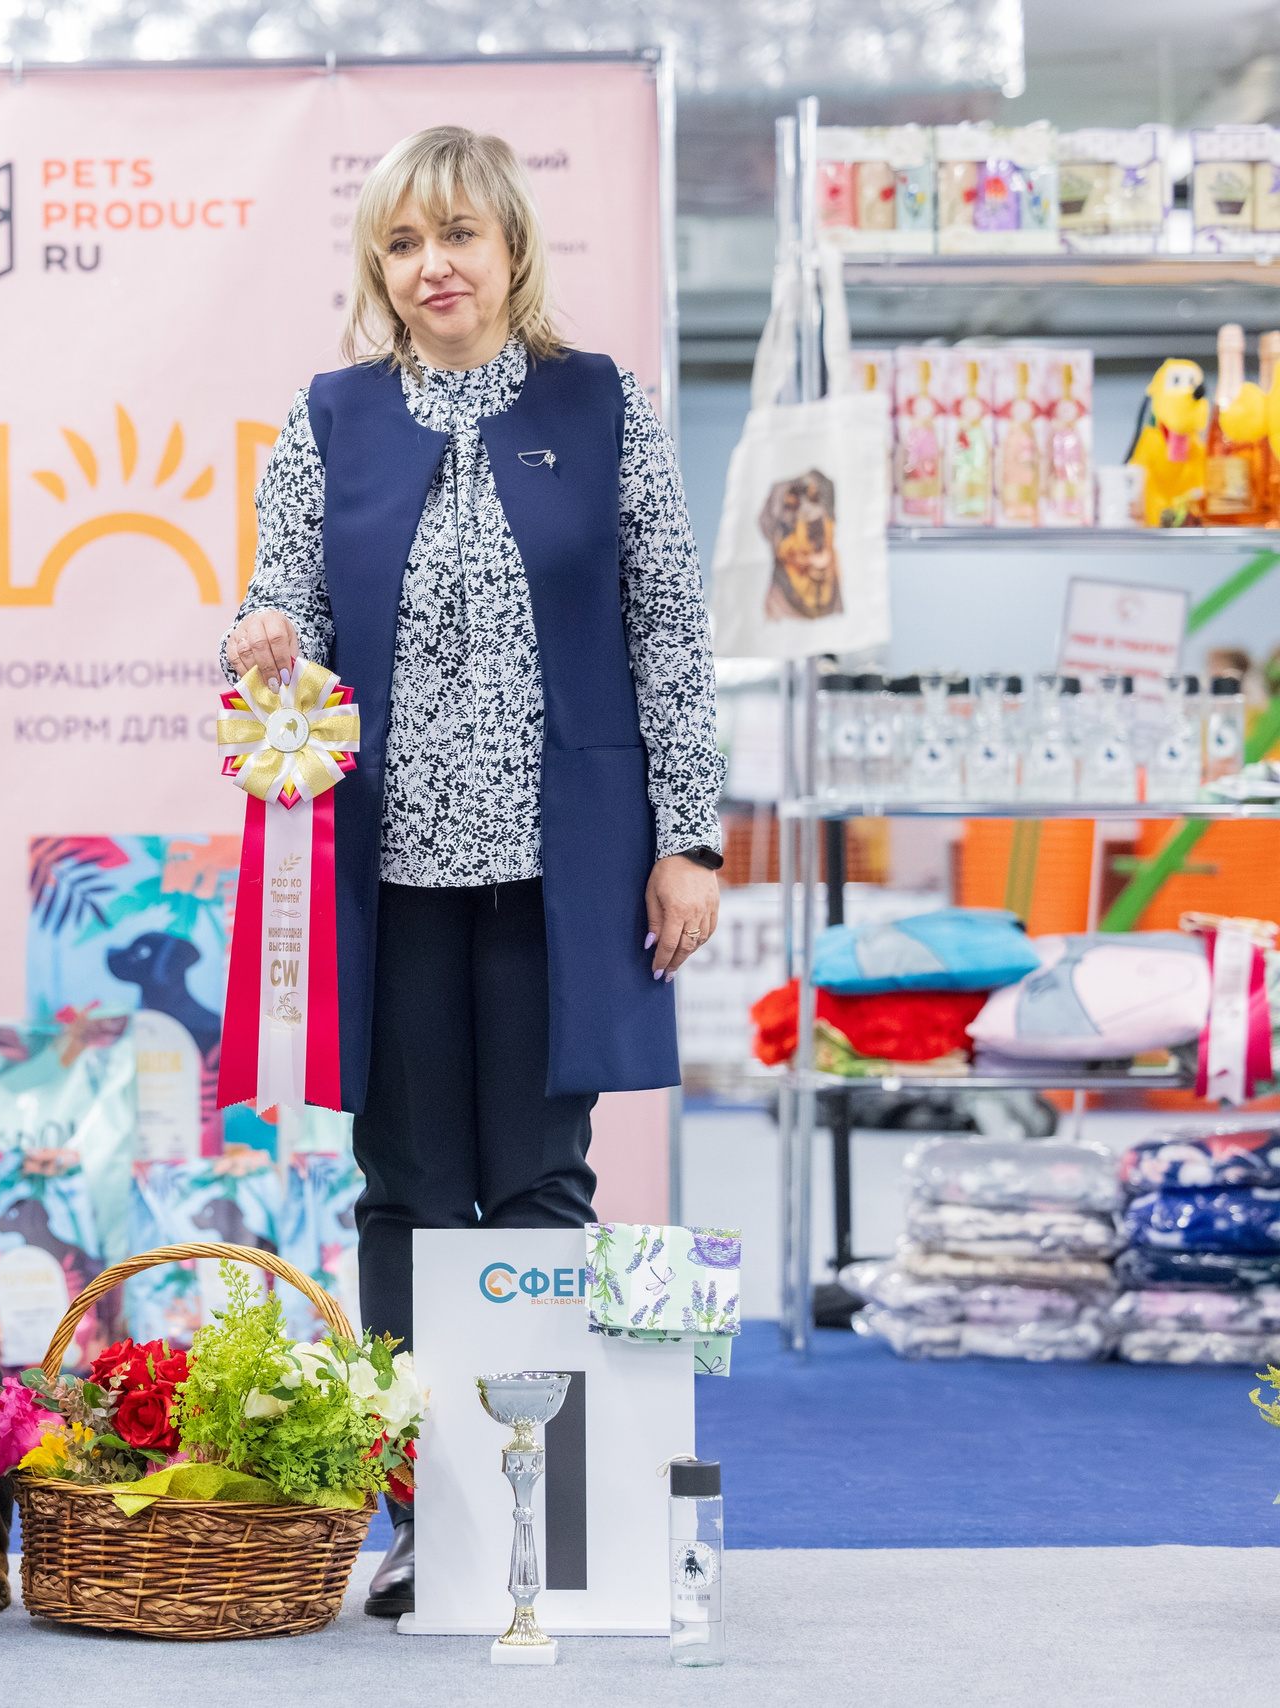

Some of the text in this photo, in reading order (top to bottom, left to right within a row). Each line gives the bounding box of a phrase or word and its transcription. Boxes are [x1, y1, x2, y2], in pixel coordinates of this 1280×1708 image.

[43, 159, 153, 188] PETS
[43, 199, 254, 229] PRODUCT
[44, 244, 101, 272] RU
[14, 714, 110, 742] КОРМ
[121, 714, 188, 745] ДЛЯ
[270, 959, 300, 987] CW
